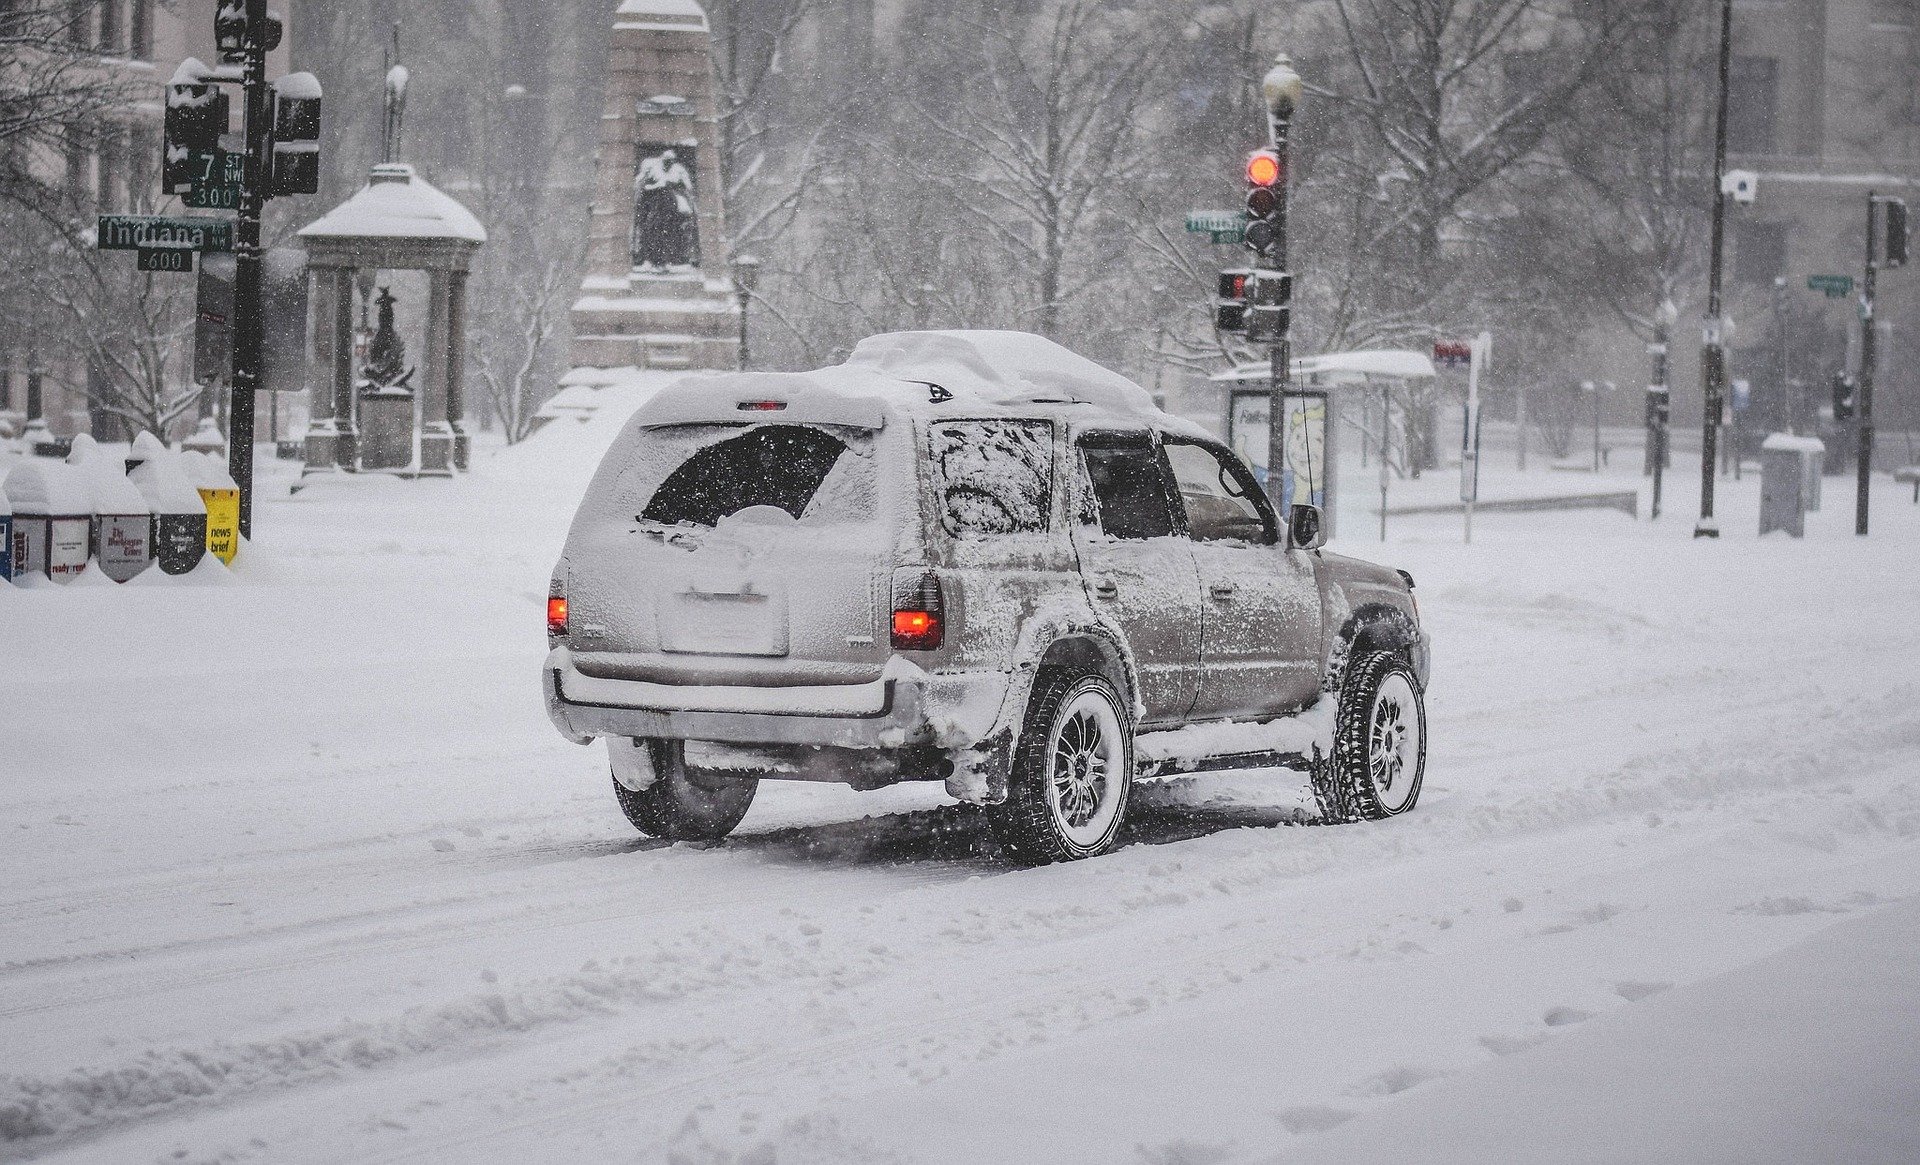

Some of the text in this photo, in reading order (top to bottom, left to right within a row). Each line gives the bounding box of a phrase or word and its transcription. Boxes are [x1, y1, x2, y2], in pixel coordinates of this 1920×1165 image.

[200, 154, 240, 180] 7 ST
[225, 168, 243, 182] NW
[199, 188, 231, 206] 300
[107, 220, 204, 247] Indiana
[149, 252, 181, 270] 600
[211, 528, 231, 538] news
[211, 540, 230, 552] brief
